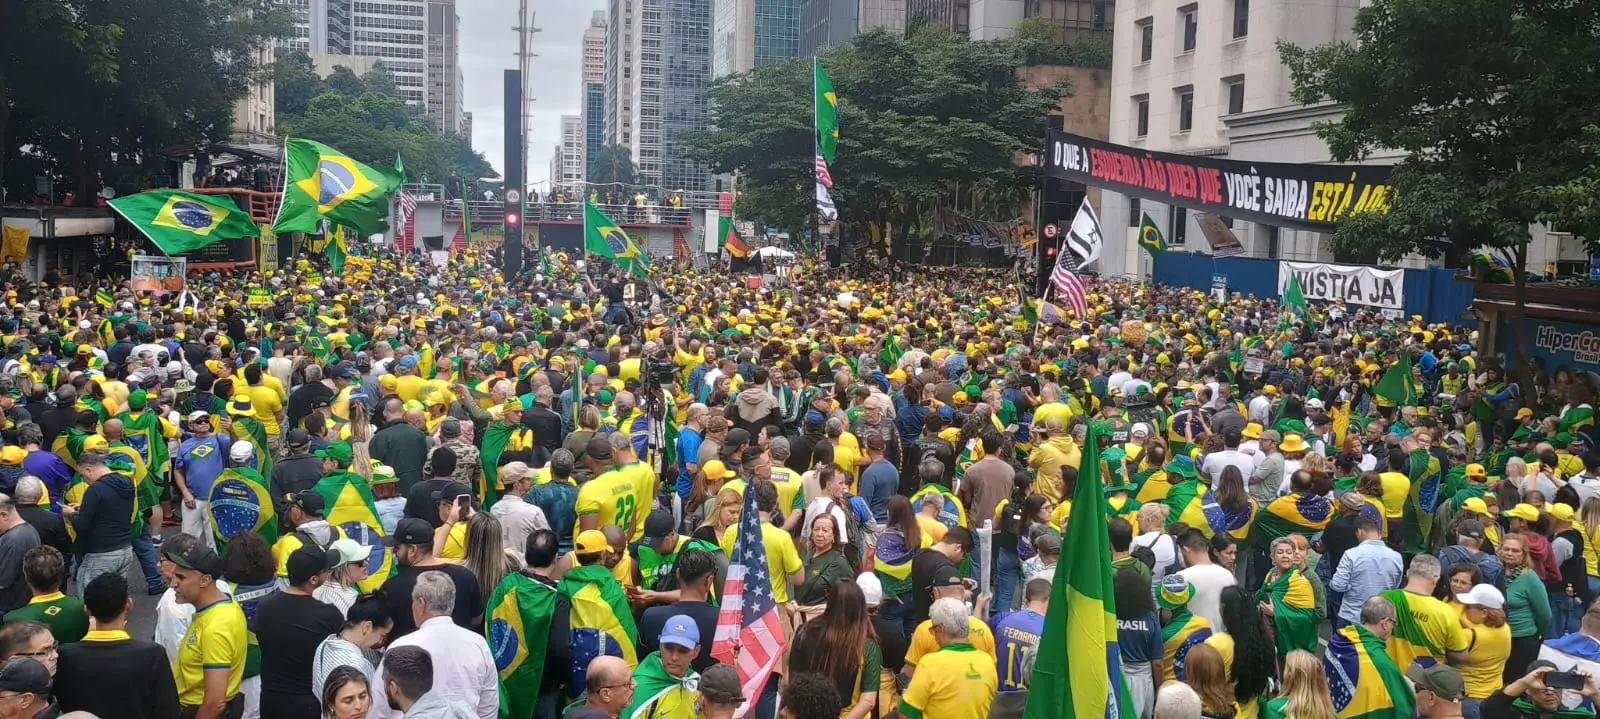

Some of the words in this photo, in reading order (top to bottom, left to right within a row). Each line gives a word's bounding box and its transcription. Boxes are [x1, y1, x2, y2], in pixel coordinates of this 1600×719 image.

[1054, 141, 1062, 167] O
[1063, 143, 1080, 171] QUE
[1082, 147, 1089, 173] A
[1090, 147, 1143, 187] ESQUERDA
[1141, 153, 1167, 192] NÃO
[1166, 163, 1198, 199] QUER
[1197, 167, 1223, 205] QUE
[1224, 166, 1260, 211] VOCÊ
[1264, 177, 1307, 219] SAIBA
[1308, 171, 1357, 222] ESTÁ
[1284, 270, 1363, 301] NISTIA
[1369, 277, 1397, 305] JA
[1112, 431, 1128, 441] 22
[615, 494, 635, 531] 22
